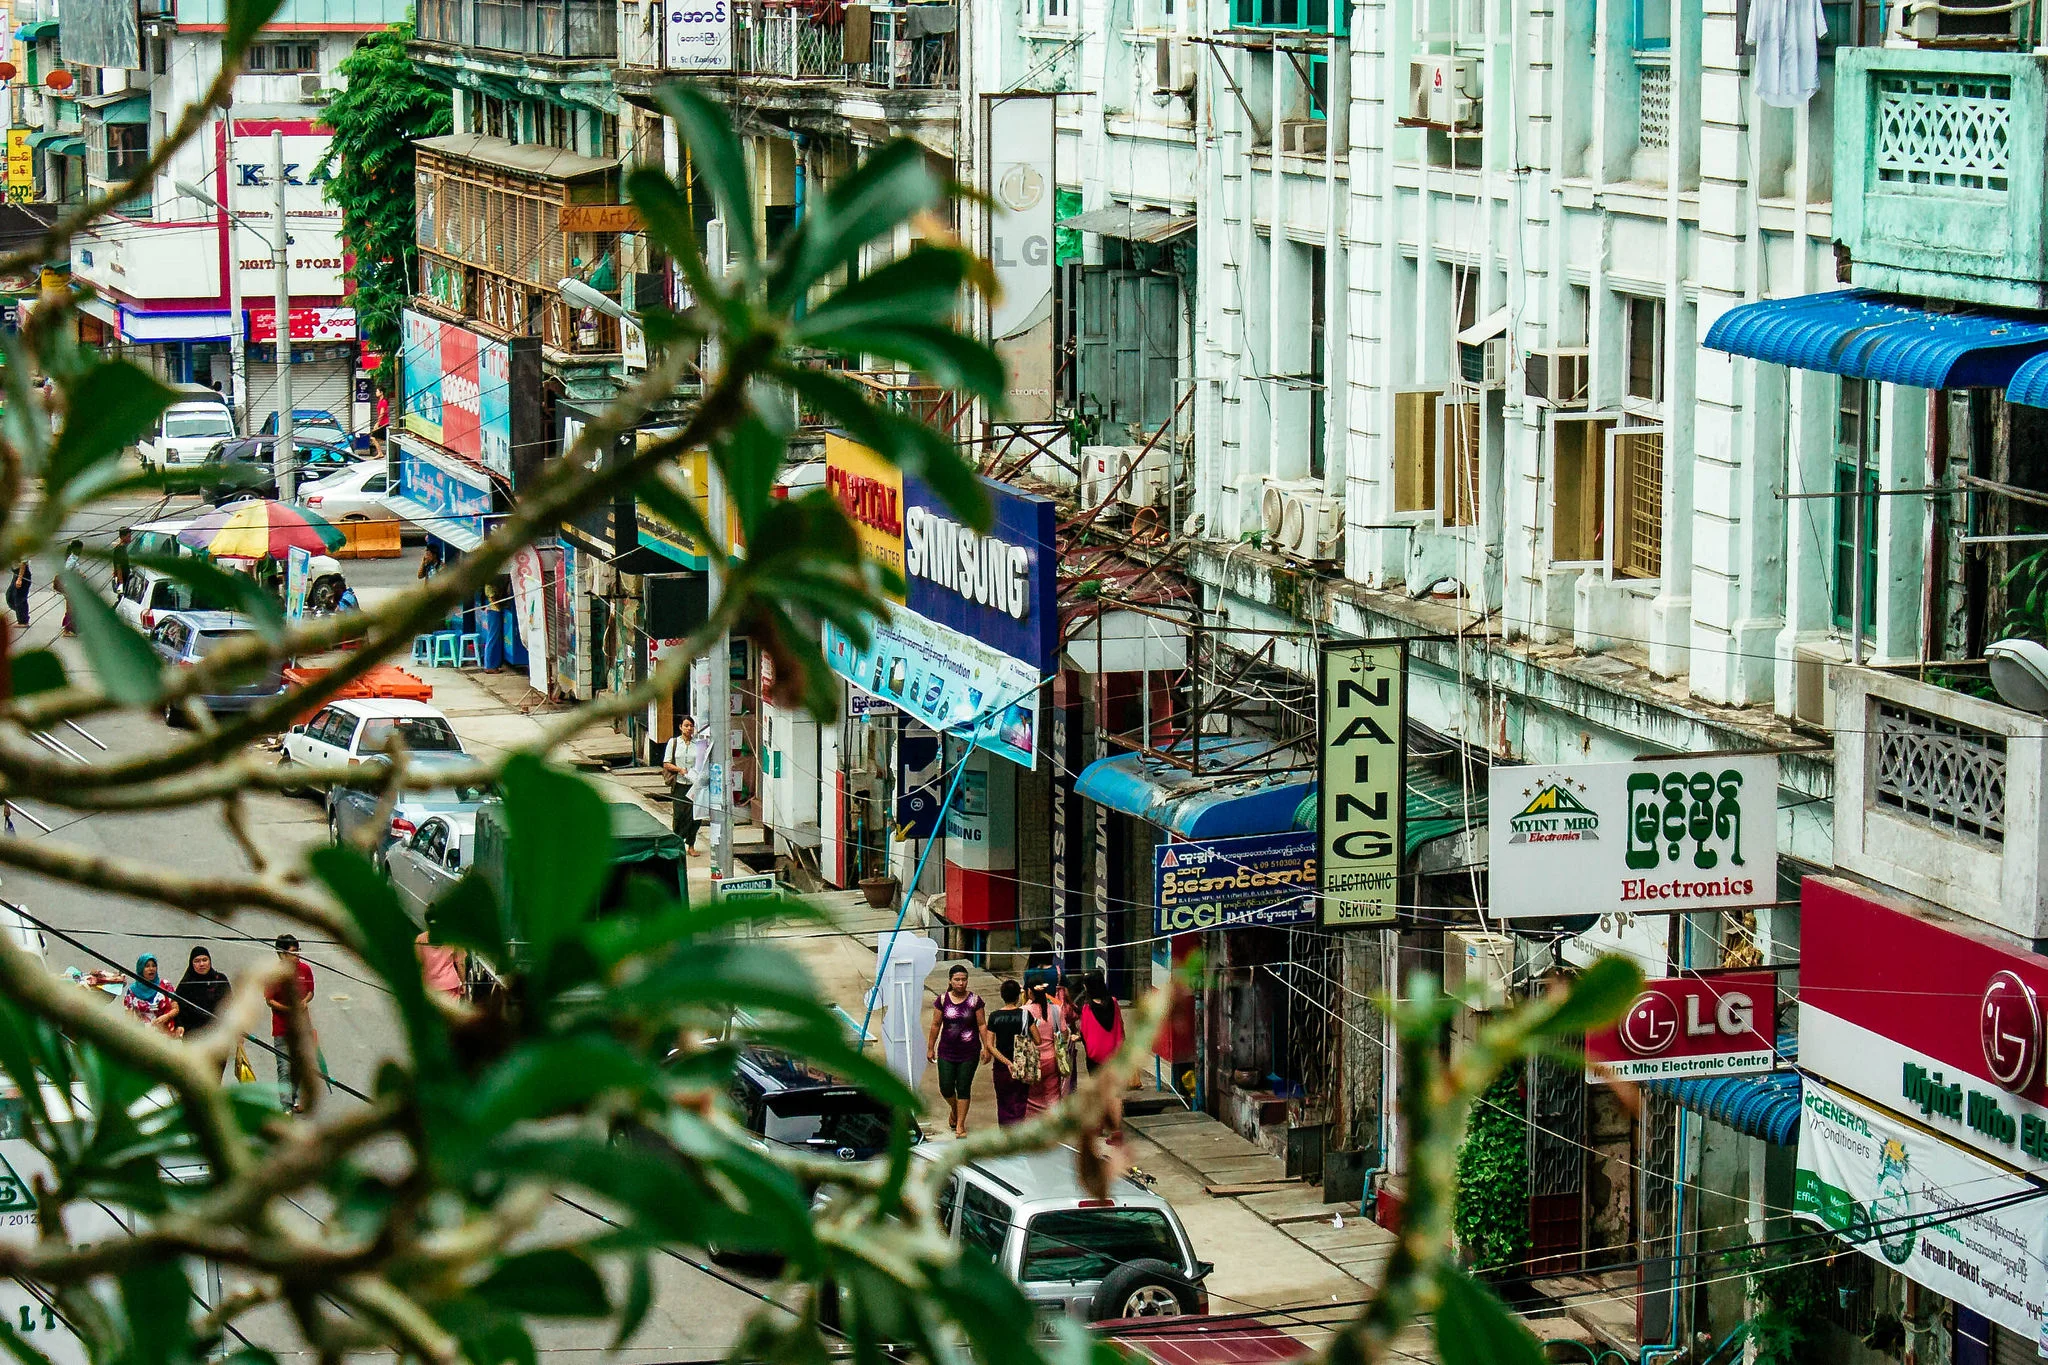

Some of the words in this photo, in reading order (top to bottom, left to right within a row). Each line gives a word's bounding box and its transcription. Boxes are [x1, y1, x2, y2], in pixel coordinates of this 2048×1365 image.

[600, 208, 623, 226] Art
[296, 258, 341, 269] STORE
[995, 235, 1049, 267] LG
[907, 506, 1029, 619] SAMSUNG
[1330, 678, 1396, 861] NAING
[1511, 818, 1559, 833] MYINT
[1564, 816, 1599, 831] MHO
[1528, 831, 1581, 843] Electronics
[1053, 719, 1067, 961] SAMSUNG
[1328, 873, 1392, 893] ELECTRONIC
[1620, 876, 1754, 901] Electronics
[1161, 902, 1222, 931] LCCI
[1339, 899, 1382, 919] SERVICE
[1686, 991, 1754, 1036] LG
[1632, 1061, 1658, 1075] Mho
[1662, 1058, 1724, 1073] Electronic
[1727, 1055, 1769, 1067] Centre
[1903, 1061, 1963, 1121] Myint
[1967, 1090, 2016, 1144] Mho
[1813, 1097, 1872, 1139] GENERAL
[9, 1213, 38, 1226] 2012
[1921, 1236, 1946, 1268] Aircon
[1948, 1249, 1980, 1285] Bracket
